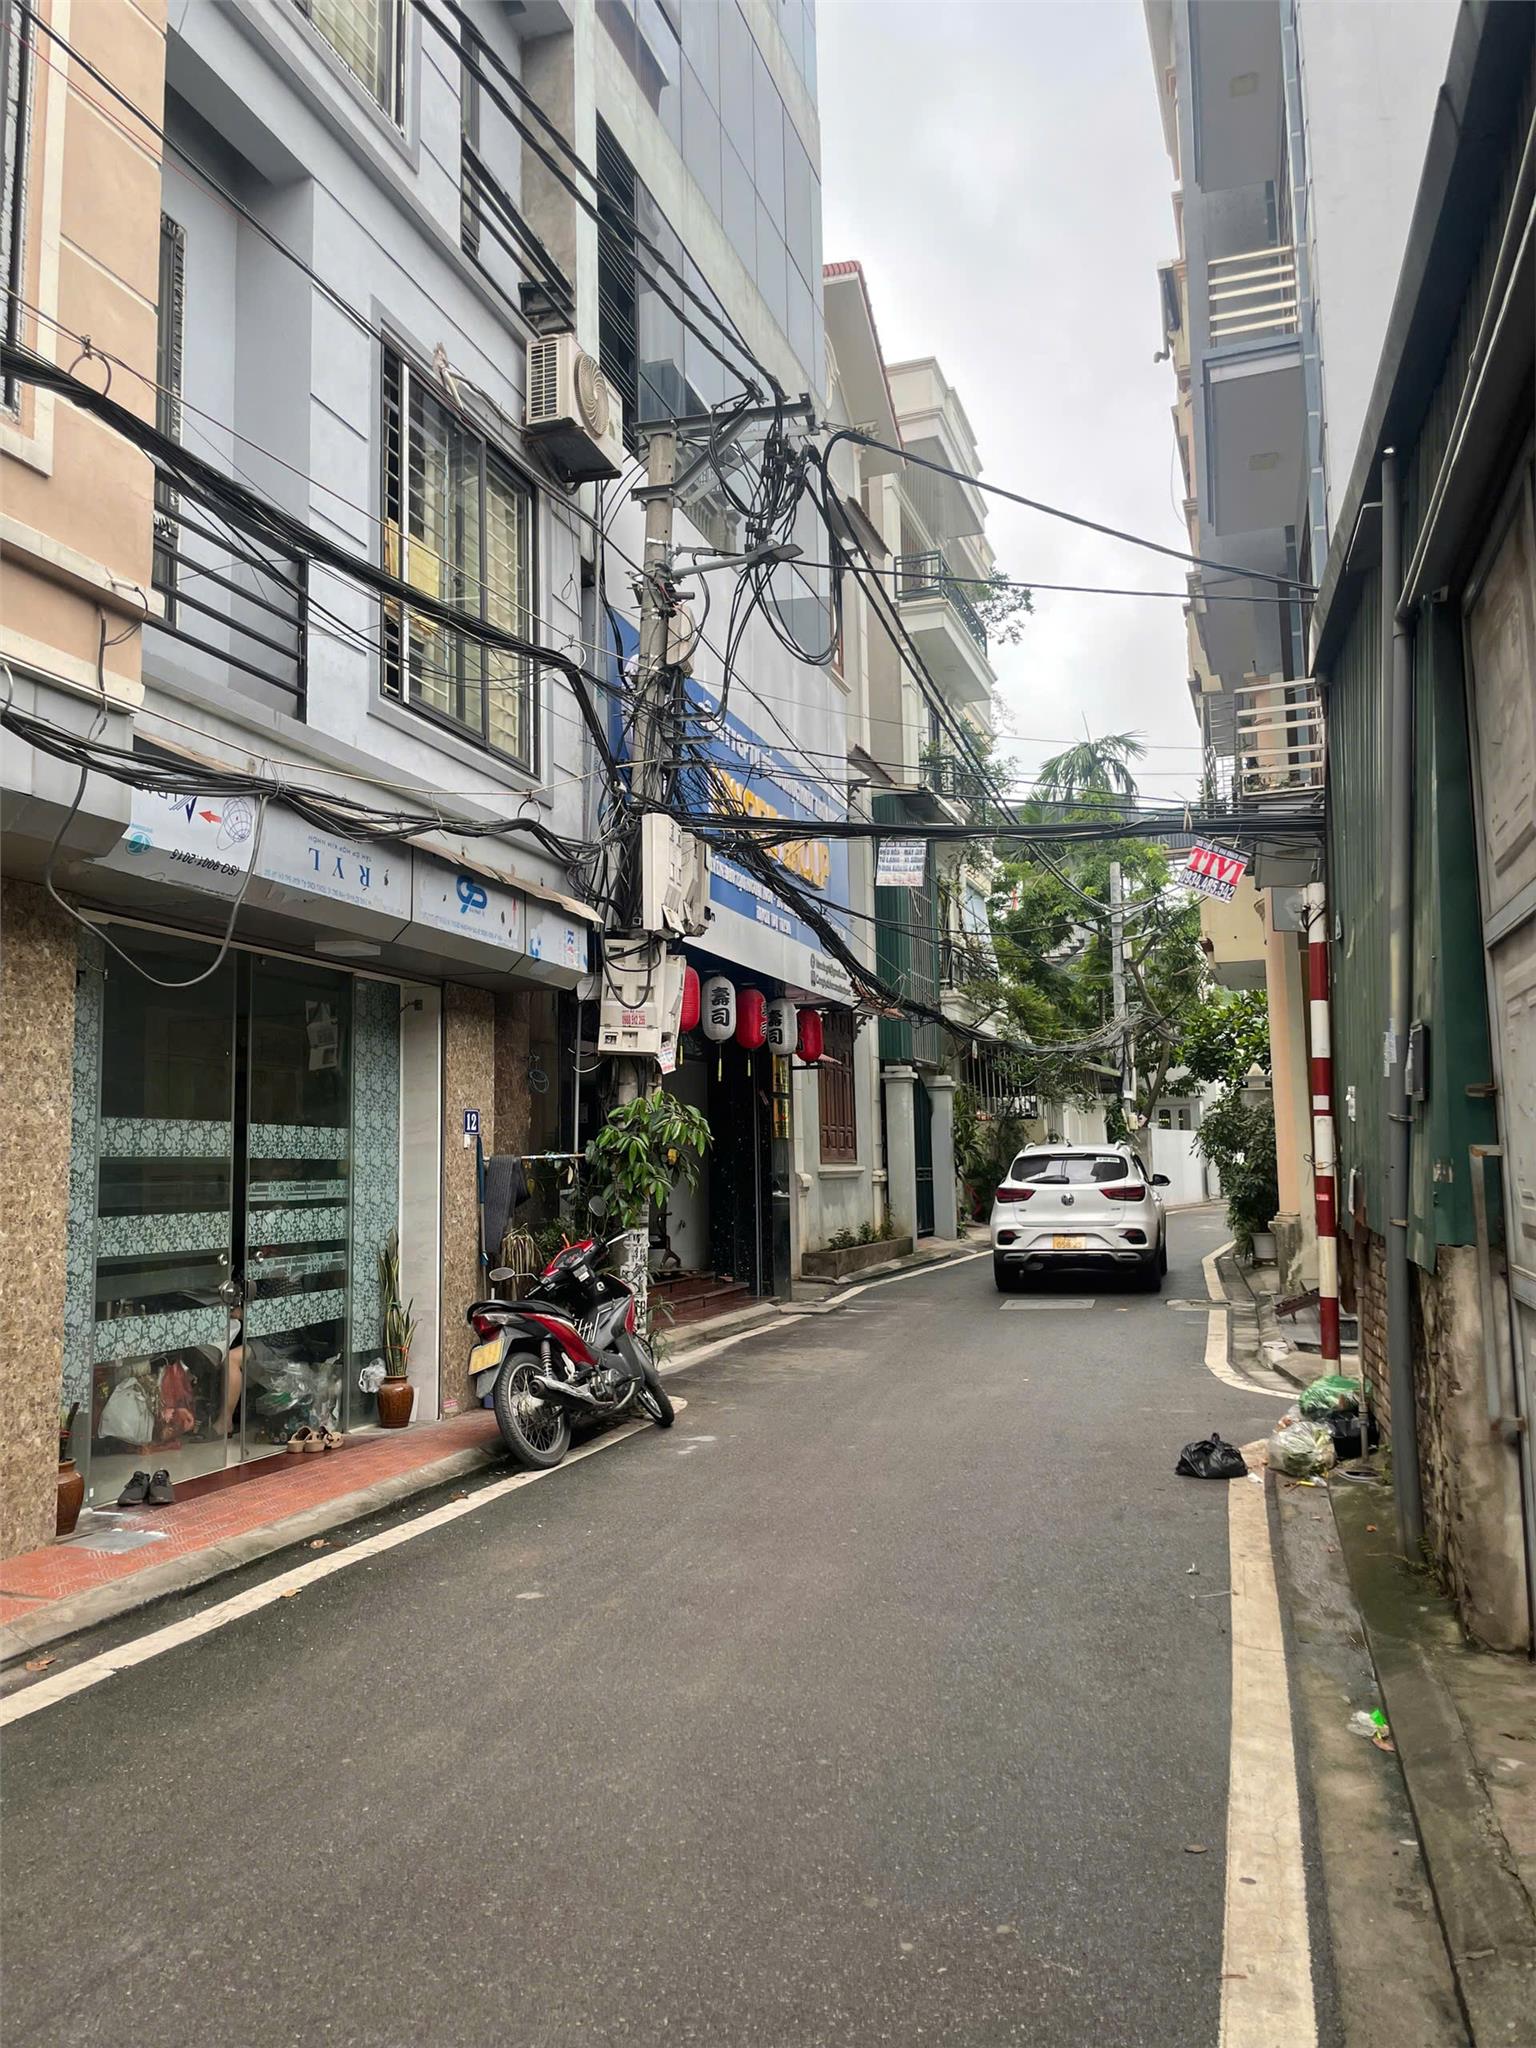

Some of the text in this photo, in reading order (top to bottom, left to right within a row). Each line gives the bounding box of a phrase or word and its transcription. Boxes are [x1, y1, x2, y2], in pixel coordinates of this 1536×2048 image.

[1188, 847, 1245, 885] TIVI
[1179, 869, 1236, 900] 0934.485.542
[466, 1113, 477, 1131] 12
